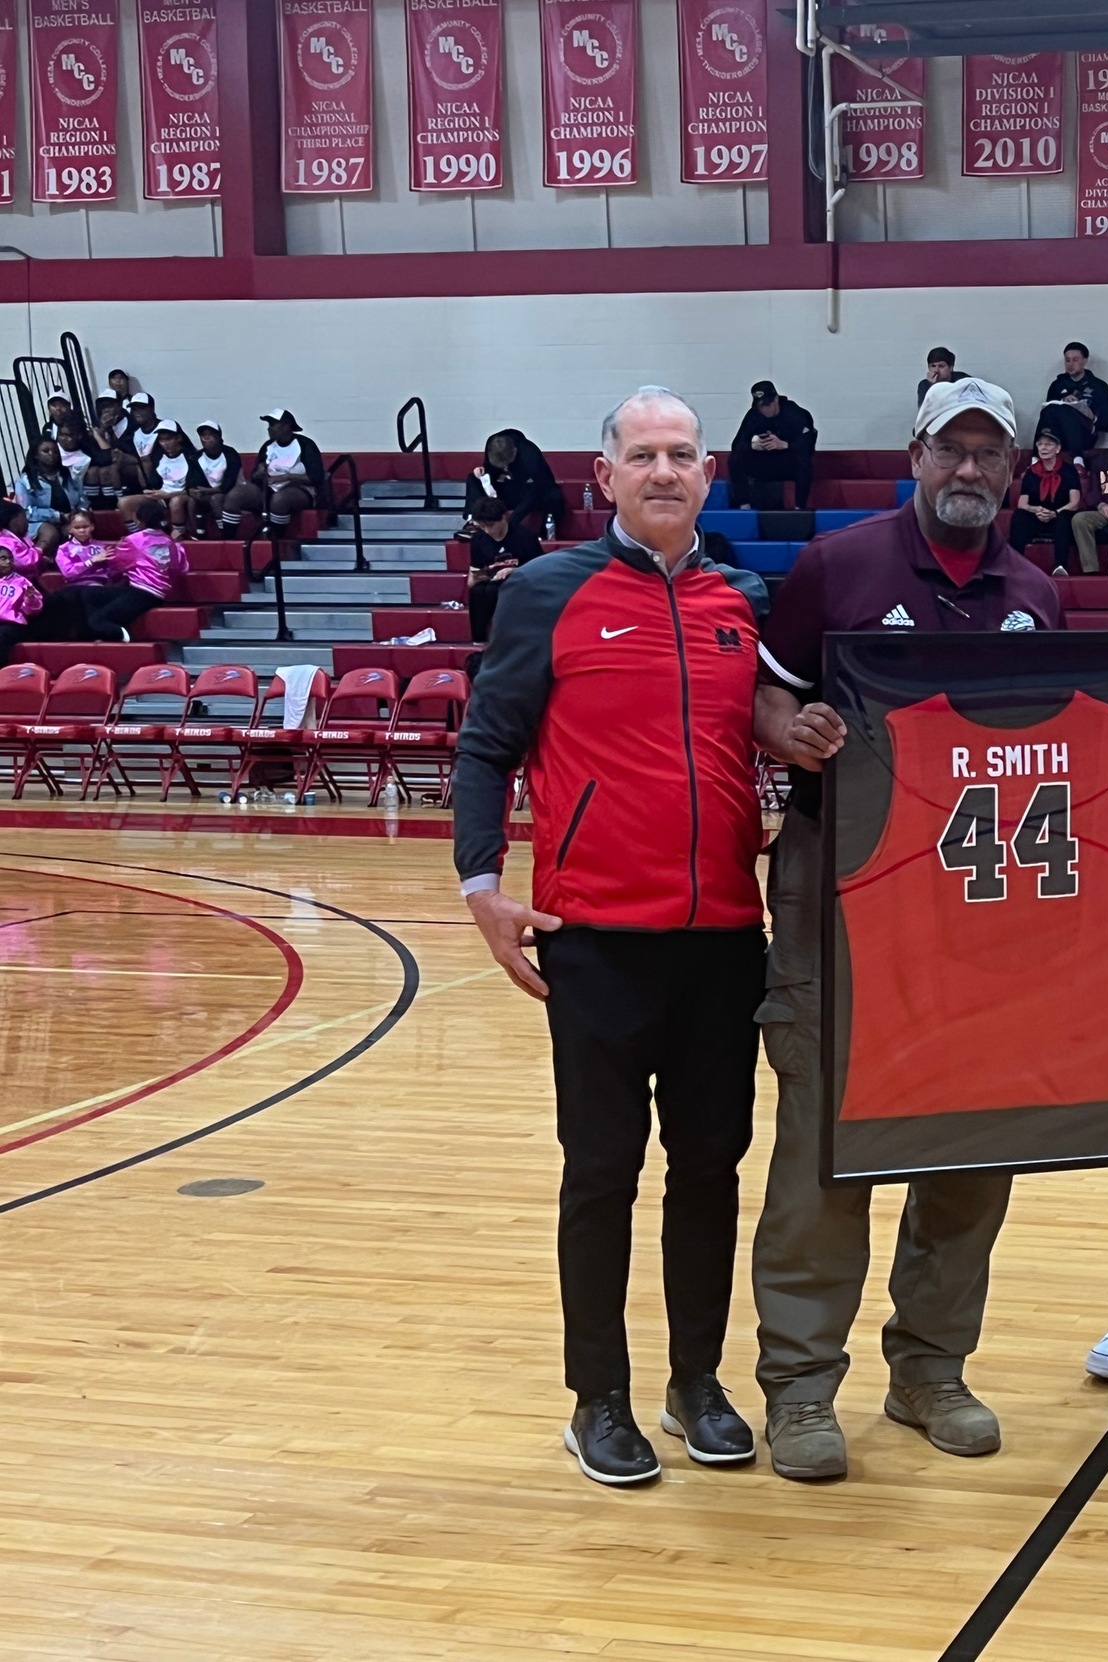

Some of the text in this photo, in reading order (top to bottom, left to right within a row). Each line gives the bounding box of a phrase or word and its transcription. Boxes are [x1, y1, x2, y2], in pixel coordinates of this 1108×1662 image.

[284, 1, 368, 14] BASKETBALL
[34, 13, 114, 28] BASKETBALL
[144, 8, 216, 23] BASKETBAL
[992, 72, 1038, 86] NJCAA
[708, 91, 754, 105] NJCAA
[856, 88, 902, 102] NJCAA
[976, 87, 1045, 101] DIVISION
[311, 100, 346, 112] NJCAA
[436, 102, 480, 115] NJCAA
[569, 96, 614, 110] NJCAA
[981, 102, 1039, 116] REGION
[168, 112, 211, 125] NJCAA
[302, 112, 357, 124] NATIONAL
[560, 110, 614, 126] REGION
[700, 106, 754, 120] REGION
[58, 117, 100, 129] NJCAA
[428, 116, 480, 130] REGION
[688, 120, 767, 135] CHAMPION
[846, 116, 923, 132] HAMPIONS
[970, 116, 1060, 132] CHAMPIONS
[50, 131, 96, 143] REGION
[160, 126, 211, 140] REGION
[416, 130, 500, 144] CHAMPIONS
[550, 124, 635, 140] CHAMPIONS
[150, 140, 220, 154] CHAMPION
[298, 137, 366, 149] THIRD PLACE
[40, 144, 116, 158] CHAMPIONS
[974, 136, 1056, 168] 2010
[555, 148, 632, 180] 1996
[694, 143, 768, 175] 1997
[294, 157, 366, 186] 1987
[422, 152, 496, 184] 1990
[45, 166, 113, 196] 1983
[156, 162, 222, 192] 1987
[882, 618, 915, 627] adidas
[952, 742, 1068, 778] R. SMITH
[937, 781, 1079, 902] 44
